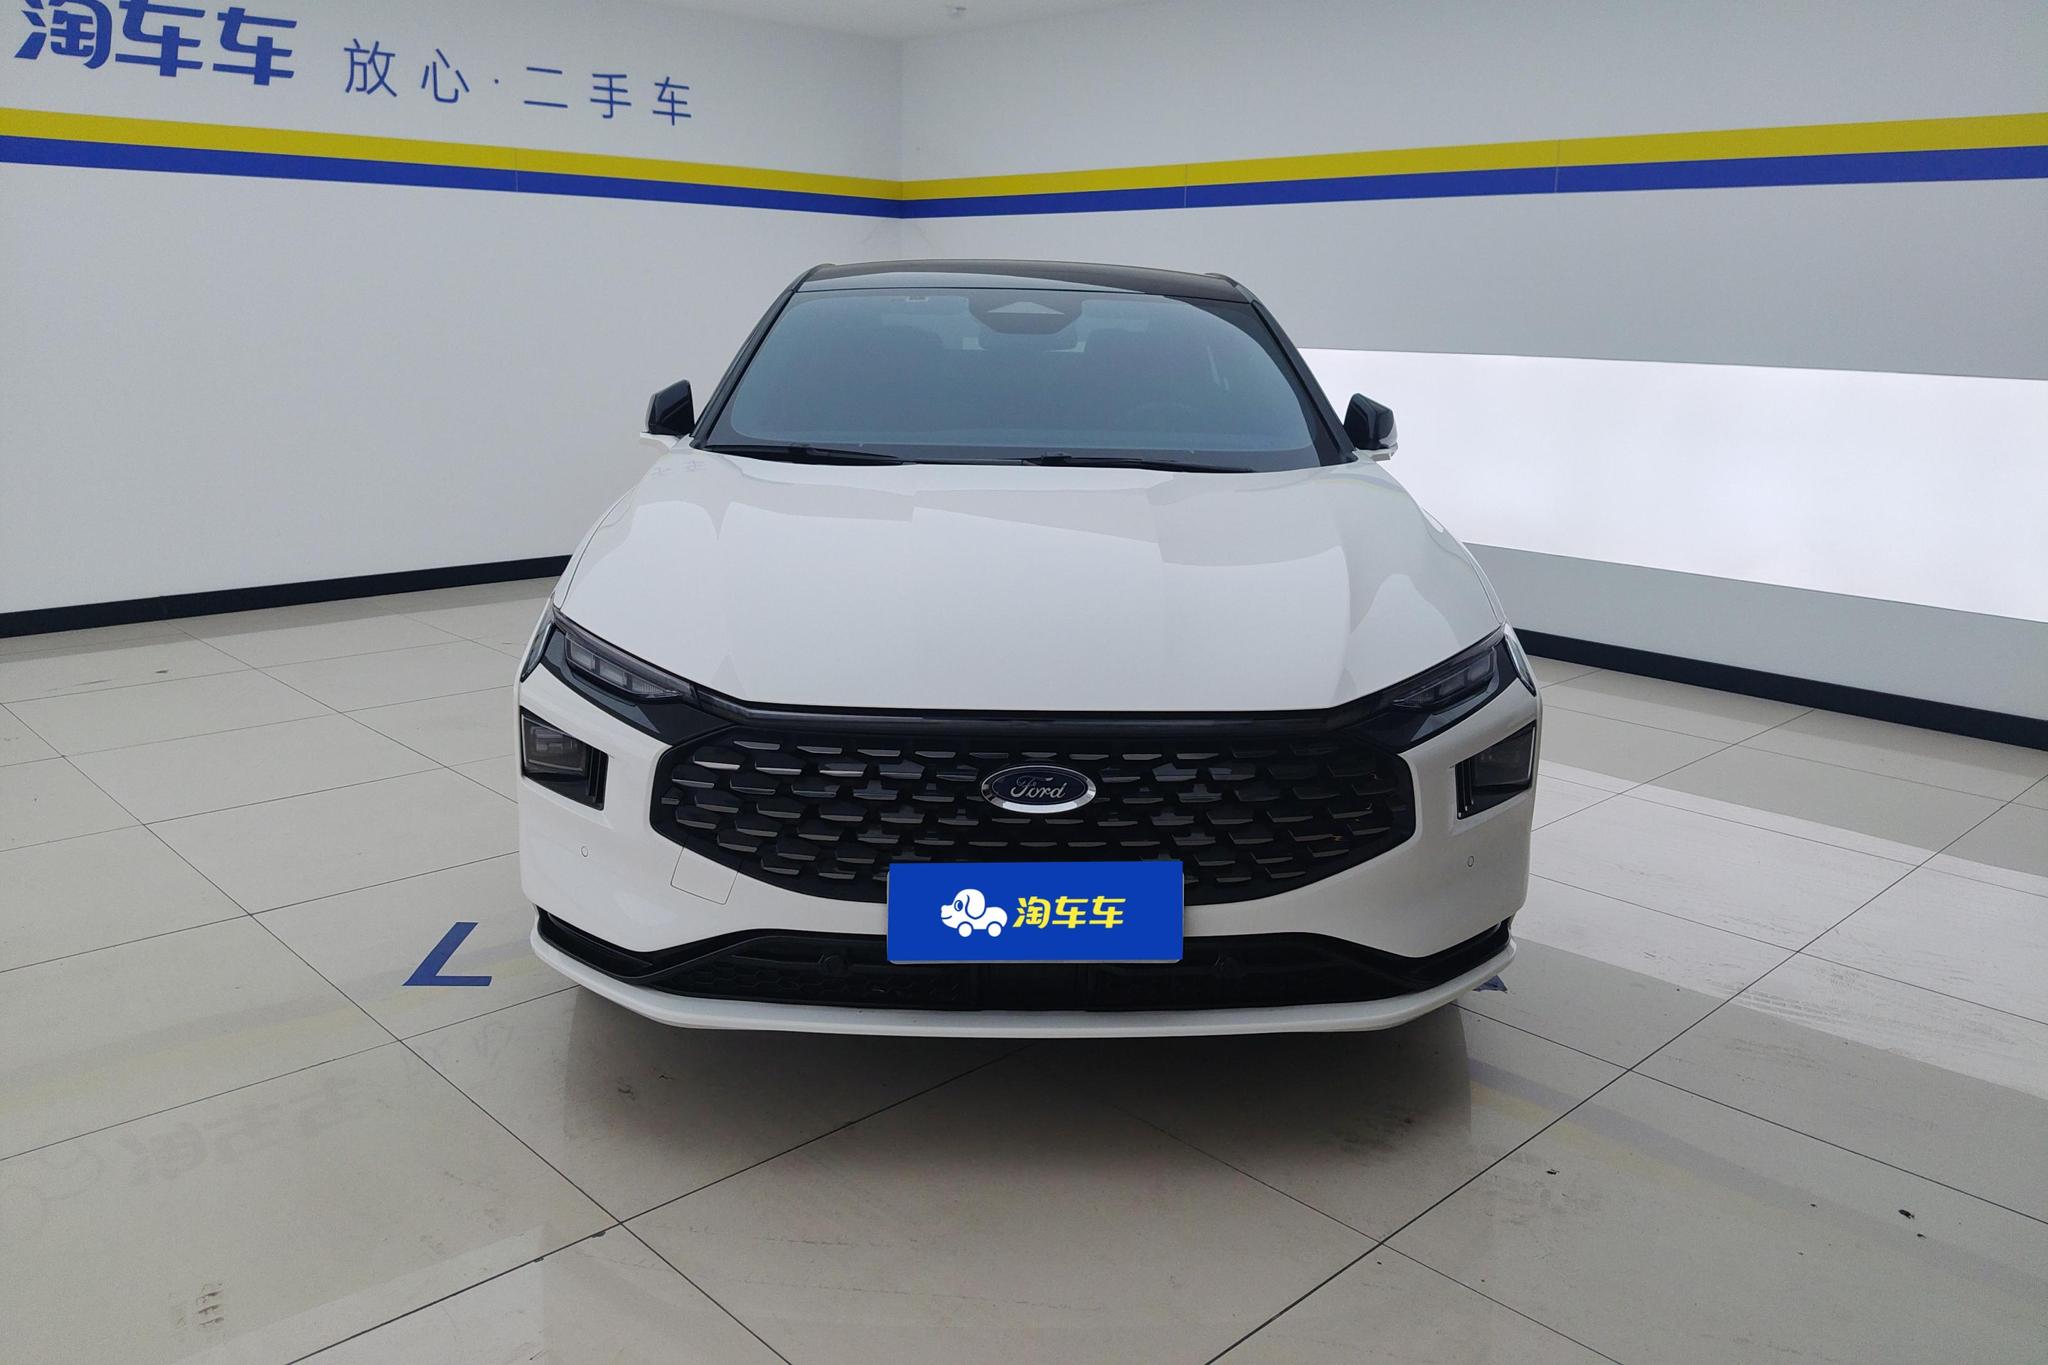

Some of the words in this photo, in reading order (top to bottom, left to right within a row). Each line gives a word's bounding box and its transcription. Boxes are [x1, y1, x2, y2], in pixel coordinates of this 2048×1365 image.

[14, 0, 297, 86] 淘车车
[1010, 775, 1068, 798] Ford
